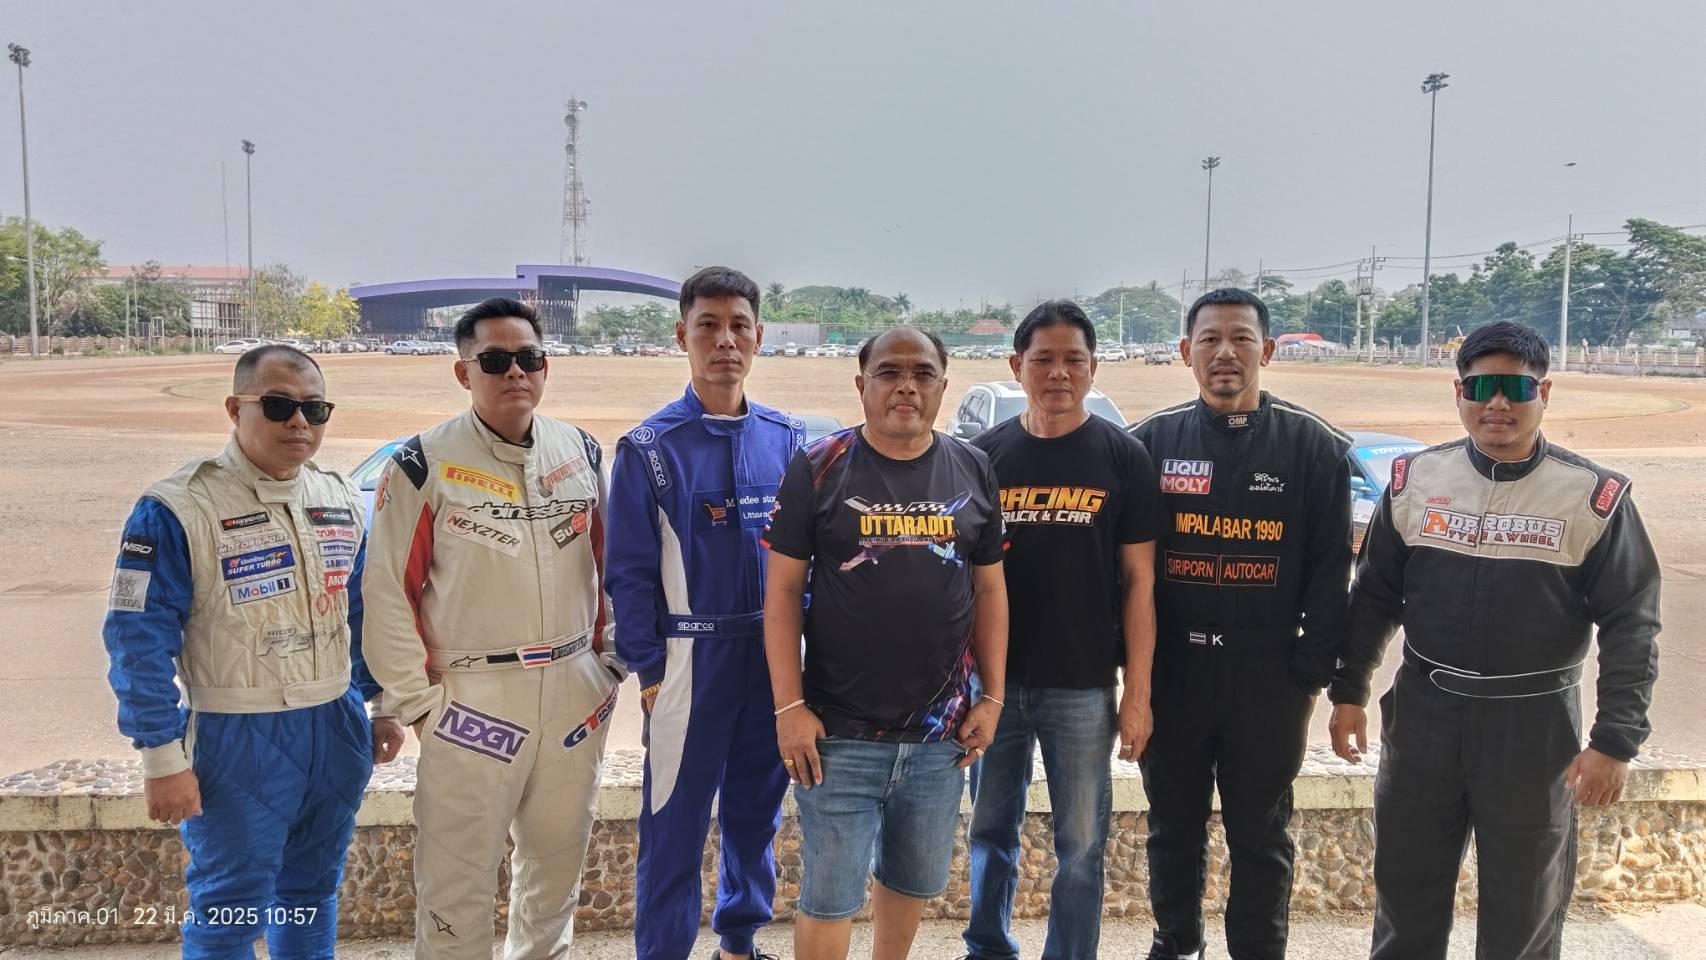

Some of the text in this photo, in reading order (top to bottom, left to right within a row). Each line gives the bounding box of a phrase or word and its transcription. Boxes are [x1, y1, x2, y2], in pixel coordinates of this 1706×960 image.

[1228, 417, 1248, 425] OMP
[647, 449, 667, 487] sparco
[1164, 461, 1210, 476] LIQUI
[447, 466, 515, 499] PIRELLI
[1161, 476, 1208, 492] MOLY
[762, 494, 777, 503] stor
[1003, 510, 1039, 523] RUCK
[1056, 510, 1091, 523] CAR
[447, 513, 521, 547] NEXZTER
[860, 515, 955, 536] UTTARADIT
[1176, 512, 1283, 541] IMPALA BAR 1990
[227, 559, 282, 575] SUPER TURBO
[1167, 558, 1275, 579] SIRIPORN AUTOCAR
[237, 581, 276, 600] Mobil
[677, 621, 715, 631] sparco
[1212, 634, 1224, 646] K
